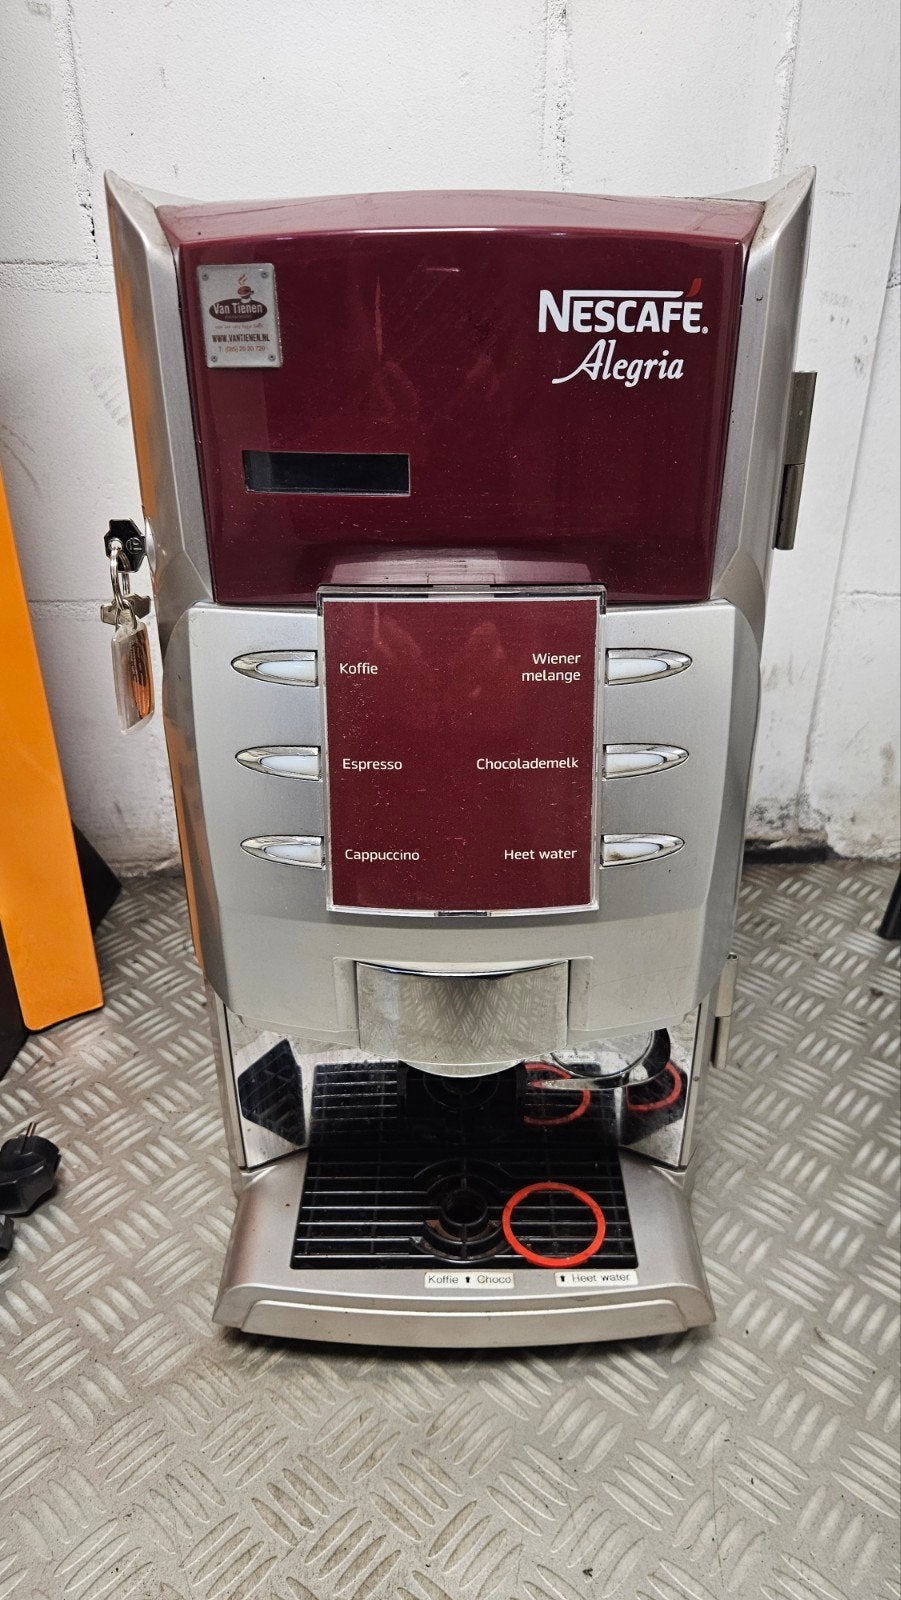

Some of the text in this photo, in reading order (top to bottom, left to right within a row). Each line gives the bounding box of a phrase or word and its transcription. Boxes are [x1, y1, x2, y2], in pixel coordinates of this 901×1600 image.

[212, 302, 263, 315] Van Tienen
[211, 334, 270, 343] WWW.VANTIENEN.NL
[551, 339, 685, 388] Alegria
[532, 652, 581, 665] Wiener
[339, 662, 378, 675] Koffie
[521, 669, 581, 683] melange
[342, 758, 403, 772] Espresso
[476, 757, 579, 770] Chocolademelk
[345, 849, 420, 864] Cappuccino
[504, 849, 577, 861] Heet water
[427, 1275, 512, 1284] Koffie Choco
[571, 1273, 630, 1283] Heet water
